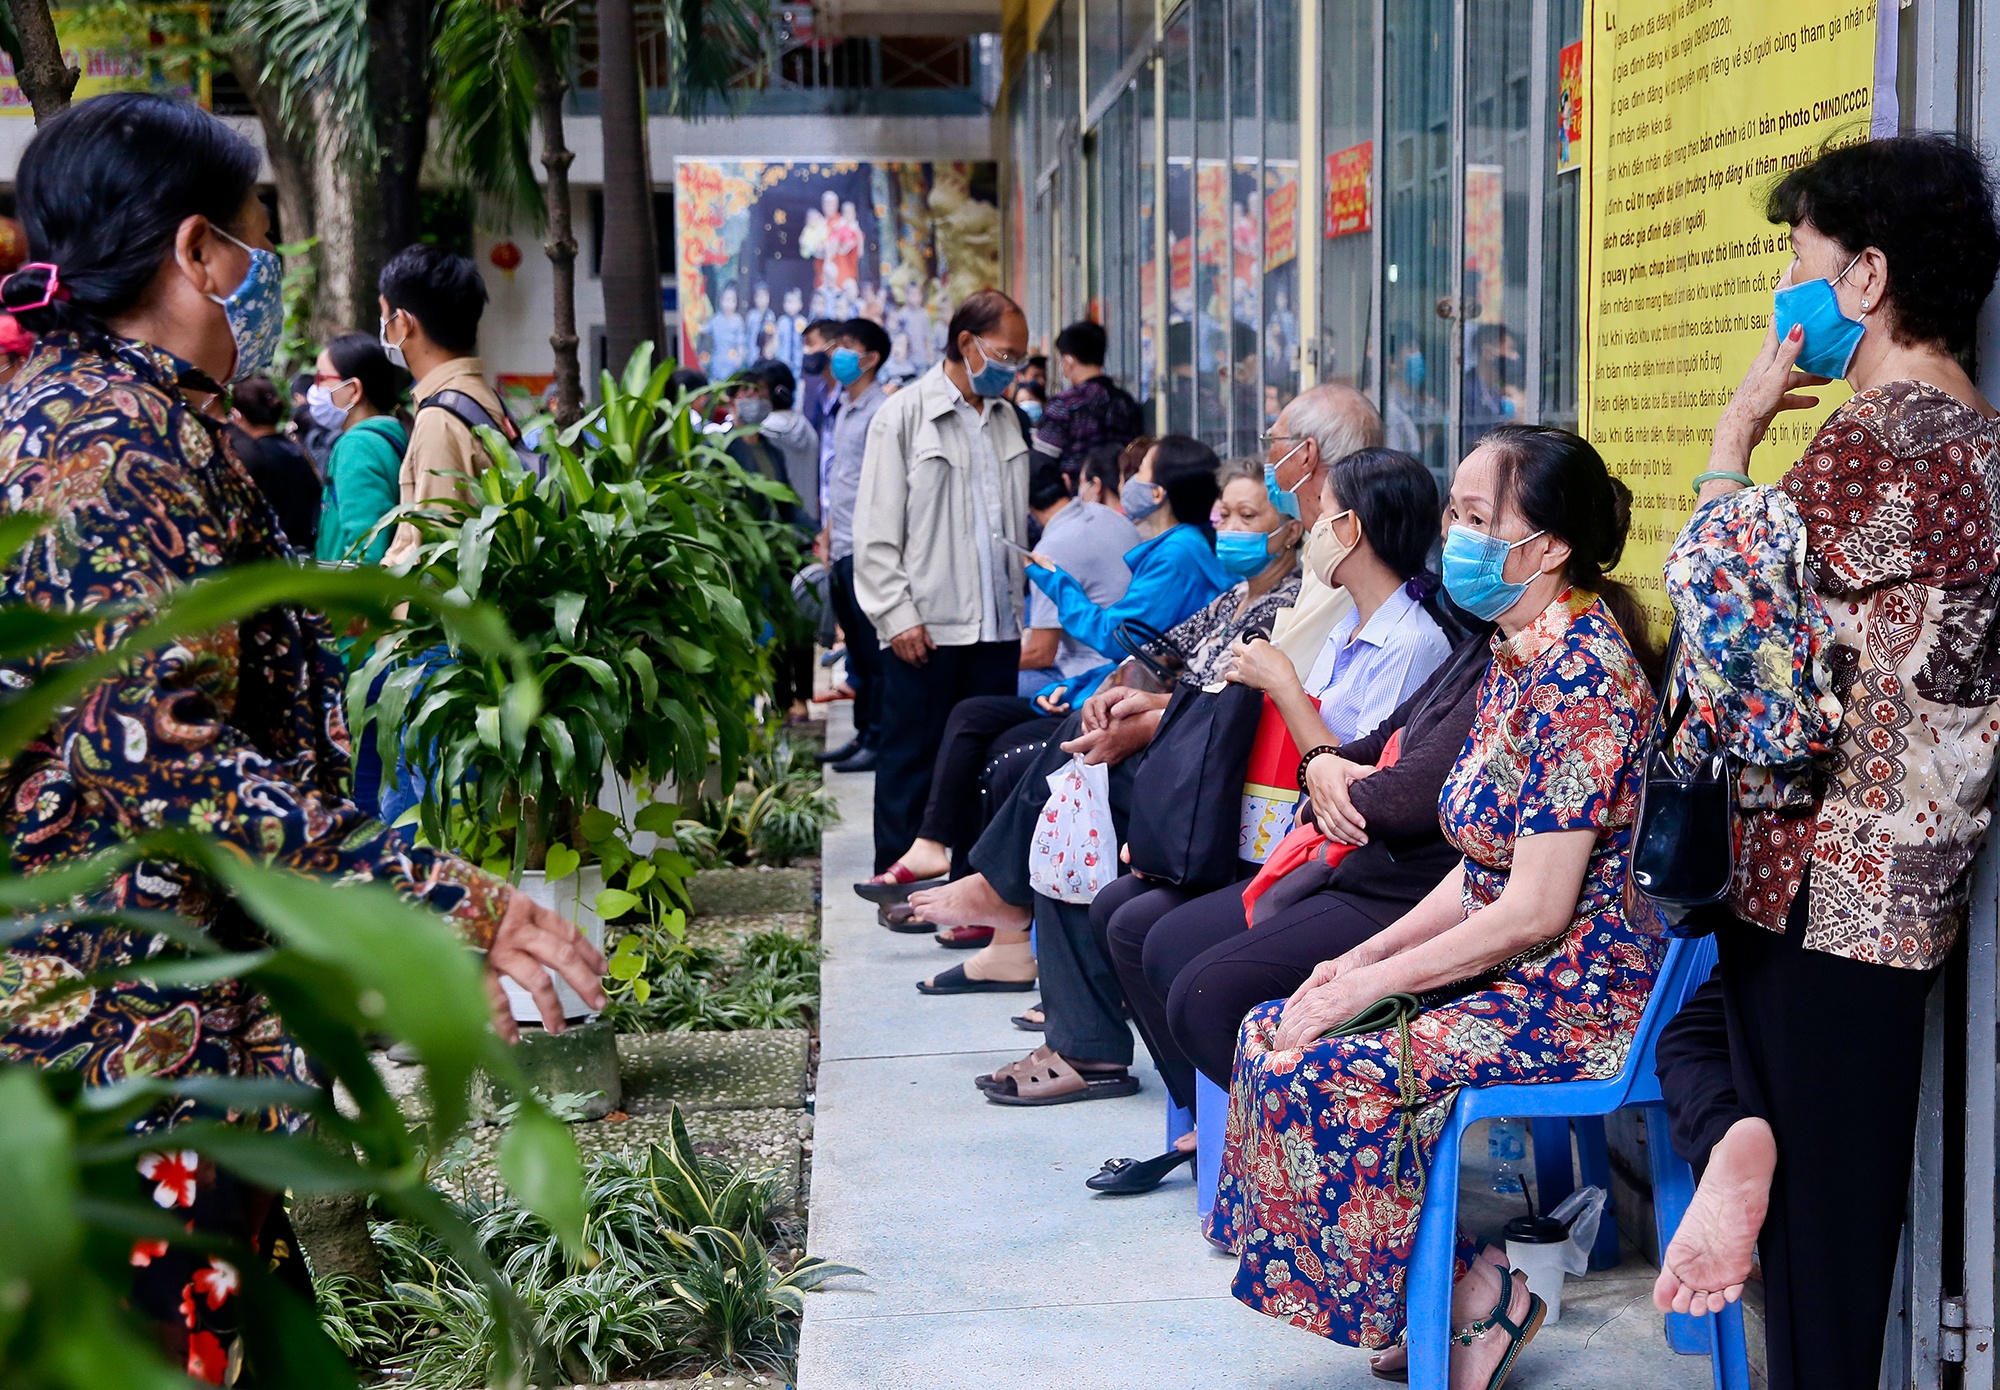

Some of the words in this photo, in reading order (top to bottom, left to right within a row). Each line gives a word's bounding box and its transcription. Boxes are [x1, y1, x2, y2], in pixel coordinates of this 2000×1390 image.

[1629, 22, 1645, 42] đình
[1617, 95, 1629, 116] gia
[1631, 88, 1645, 108] đình
[1646, 85, 1663, 104] đăng
[1711, 55, 1730, 76] riêng
[1743, 41, 1753, 65] số
[1754, 34, 1772, 64] người
[1774, 31, 1797, 53] cùng
[1800, 24, 1826, 45] tham
[1828, 14, 1841, 42] gia
[1844, 5, 1864, 31] nhận
[1617, 61, 1628, 84] gia
[1629, 55, 1645, 75] đình
[1646, 51, 1663, 70] đăng
[1616, 125, 1635, 146] nhận
[1618, 159, 1631, 179] khi
[1632, 155, 1644, 176] đến
[1645, 153, 1662, 174] nhận
[1700, 130, 1713, 154] bản
[1714, 125, 1738, 150] chính
[1746, 119, 1756, 140] 01
[1759, 112, 1776, 136] bản
[1778, 106, 1811, 136] photo
[1625, 191, 1636, 212] cử
[1708, 169, 1724, 191] hợp
[1725, 163, 1743, 186] đăng
[1744, 157, 1755, 179] kí
[1755, 153, 1778, 176] thêm
[1604, 230, 1618, 250] ách
[1619, 230, 1636, 248] các
[1636, 229, 1646, 249] gia
[1606, 266, 1628, 287] quay
[1687, 248, 1700, 267] khu
[1701, 249, 1715, 269] vực
[1715, 241, 1728, 262] thờ
[1728, 239, 1745, 261] linh
[1746, 232, 1761, 257] cốt
[1762, 236, 1776, 255] và
[1777, 230, 1787, 253] di
[1613, 296, 1634, 314] nhân
[1697, 282, 1709, 300] khu
[1710, 282, 1723, 302] vực
[1723, 276, 1736, 297] thờ
[1736, 275, 1751, 295] linh
[1752, 269, 1768, 296] cốt,
[1610, 327, 1623, 347] khi
[1624, 326, 1639, 345] vào
[1700, 315, 1714, 336] các
[1750, 313, 1770, 331] sau:
[1606, 361, 1621, 380] bàn
[1622, 360, 1641, 381] nhận
[1699, 349, 1709, 372] hỗ
[1612, 393, 1630, 414] diện
[1699, 388, 1716, 407] đánh
[1717, 384, 1727, 407] số
[1608, 427, 1622, 444] khi
[1624, 426, 1634, 443] đã
[1696, 427, 1713, 447] vọng
[1792, 421, 1801, 446] ký
[1802, 421, 1813, 442] tên
[1616, 458, 1628, 480] gia
[1652, 459, 1661, 476] 01
[1643, 491, 1655, 509] các
[1677, 494, 1687, 512] đã
[1639, 573, 1659, 590] chưa
